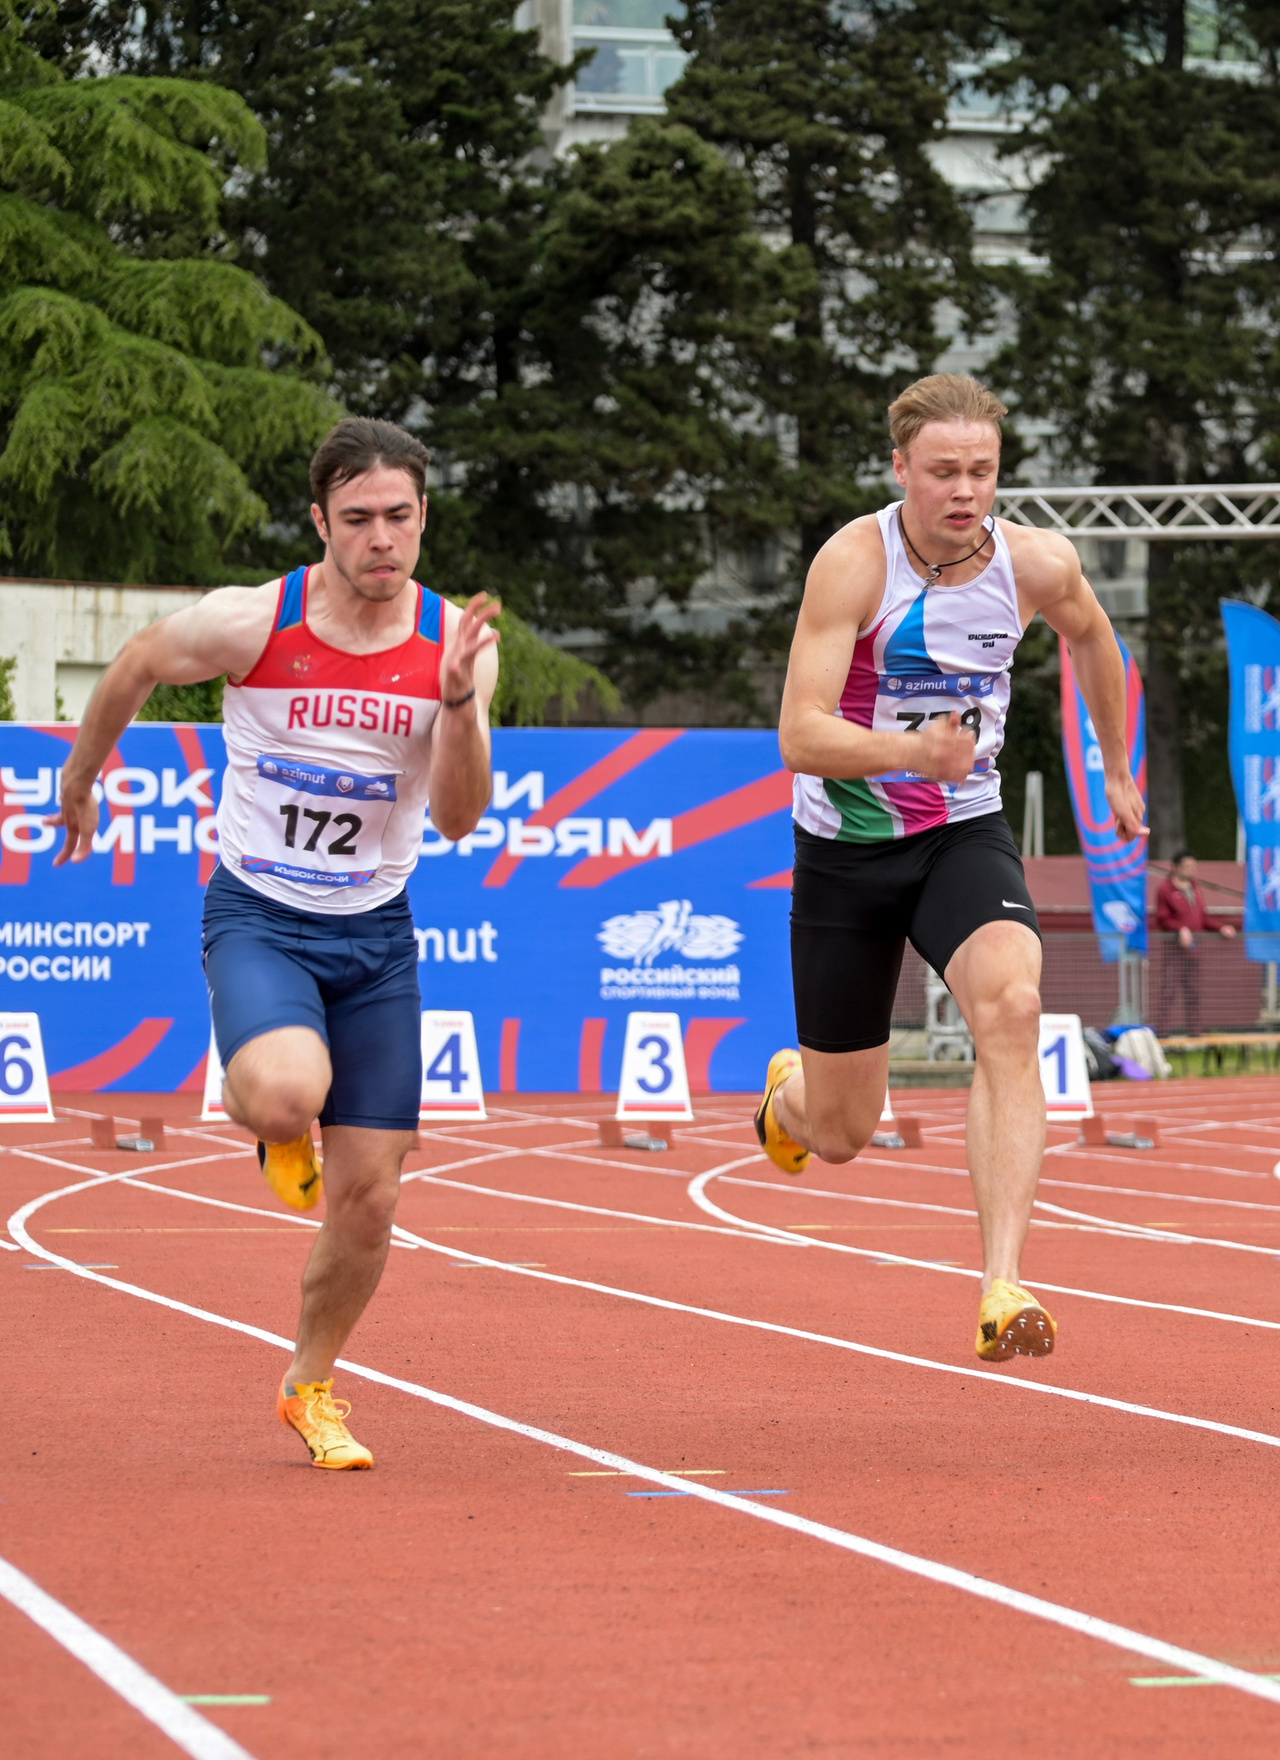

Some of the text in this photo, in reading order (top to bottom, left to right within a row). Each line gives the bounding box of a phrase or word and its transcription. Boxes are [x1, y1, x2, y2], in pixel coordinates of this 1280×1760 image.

[968, 632, 1008, 641] КРАСНОДАРСКИЙ
[982, 640, 995, 648] КРАЙ
[905, 680, 947, 690] azimut
[288, 694, 413, 737] RUSSIA
[281, 768, 326, 784] azimut
[280, 804, 362, 855] 172
[274, 866, 349, 883] КУБОК СОЧИ
[0, 921, 151, 948] МИНСПОРТ
[414, 920, 498, 963] mut
[600, 964, 741, 985] РОССИЙСКИЙ
[0, 1035, 33, 1096] 6
[426, 1033, 468, 1093] 4
[636, 1035, 674, 1094] 3
[1043, 1036, 1066, 1094] 1
